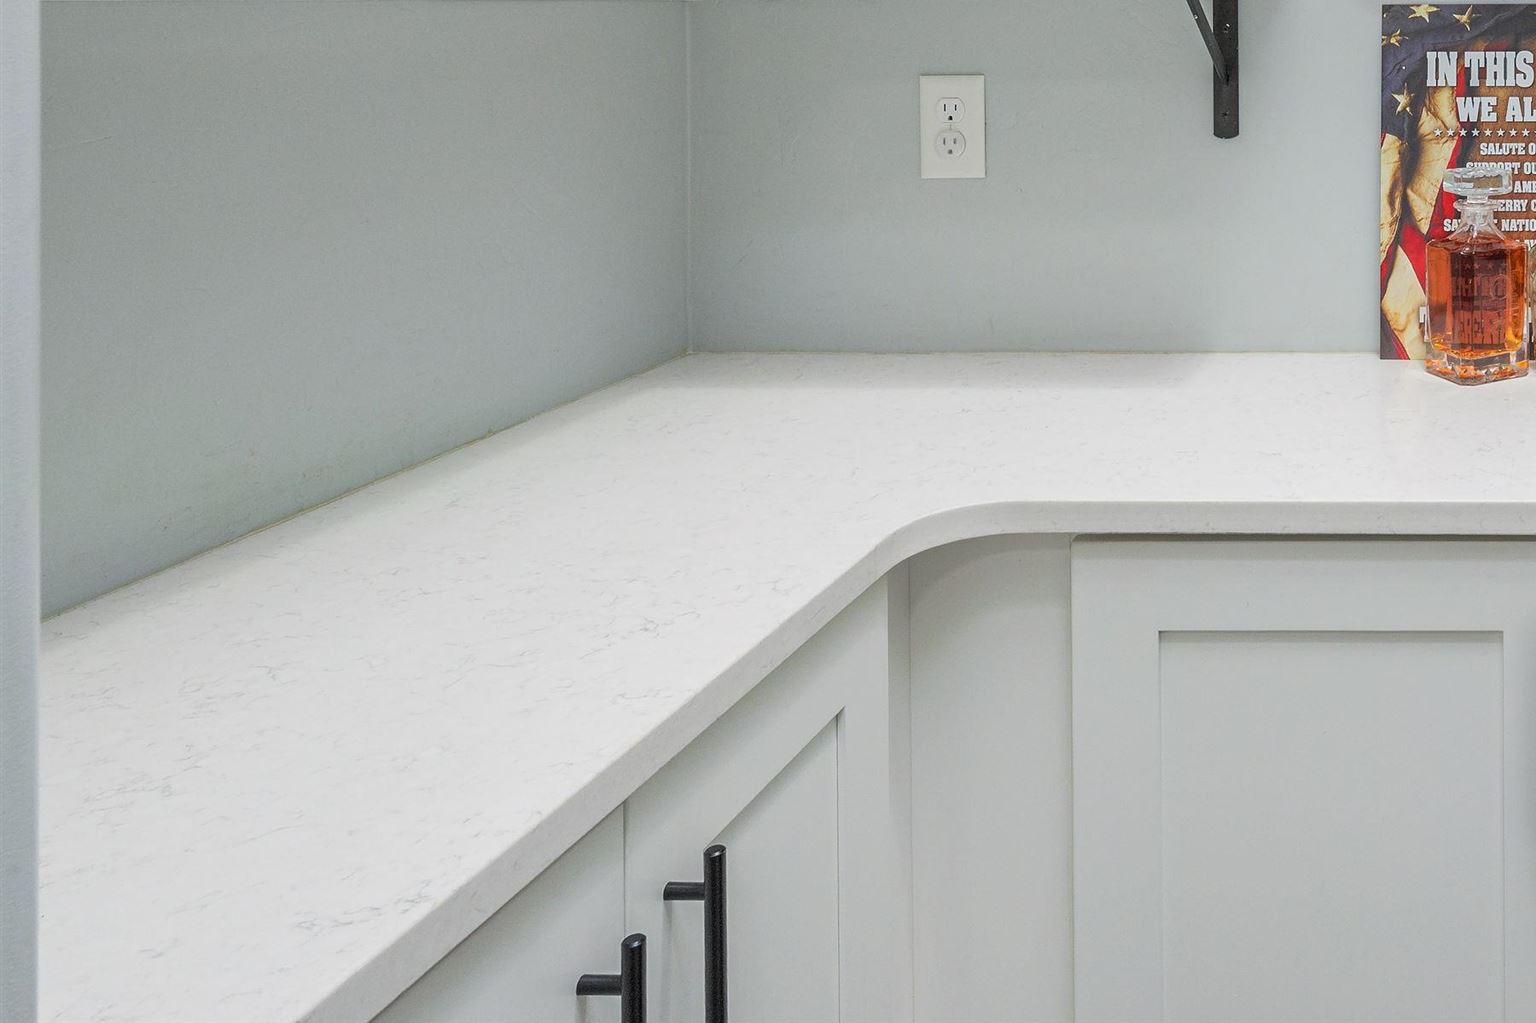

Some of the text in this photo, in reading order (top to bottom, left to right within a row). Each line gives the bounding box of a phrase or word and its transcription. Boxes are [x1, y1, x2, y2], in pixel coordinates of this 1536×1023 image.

[1427, 51, 1458, 87] IN
[1464, 51, 1535, 87] THIS
[1456, 96, 1497, 123] WE
[1480, 143, 1525, 155] SALUTE
